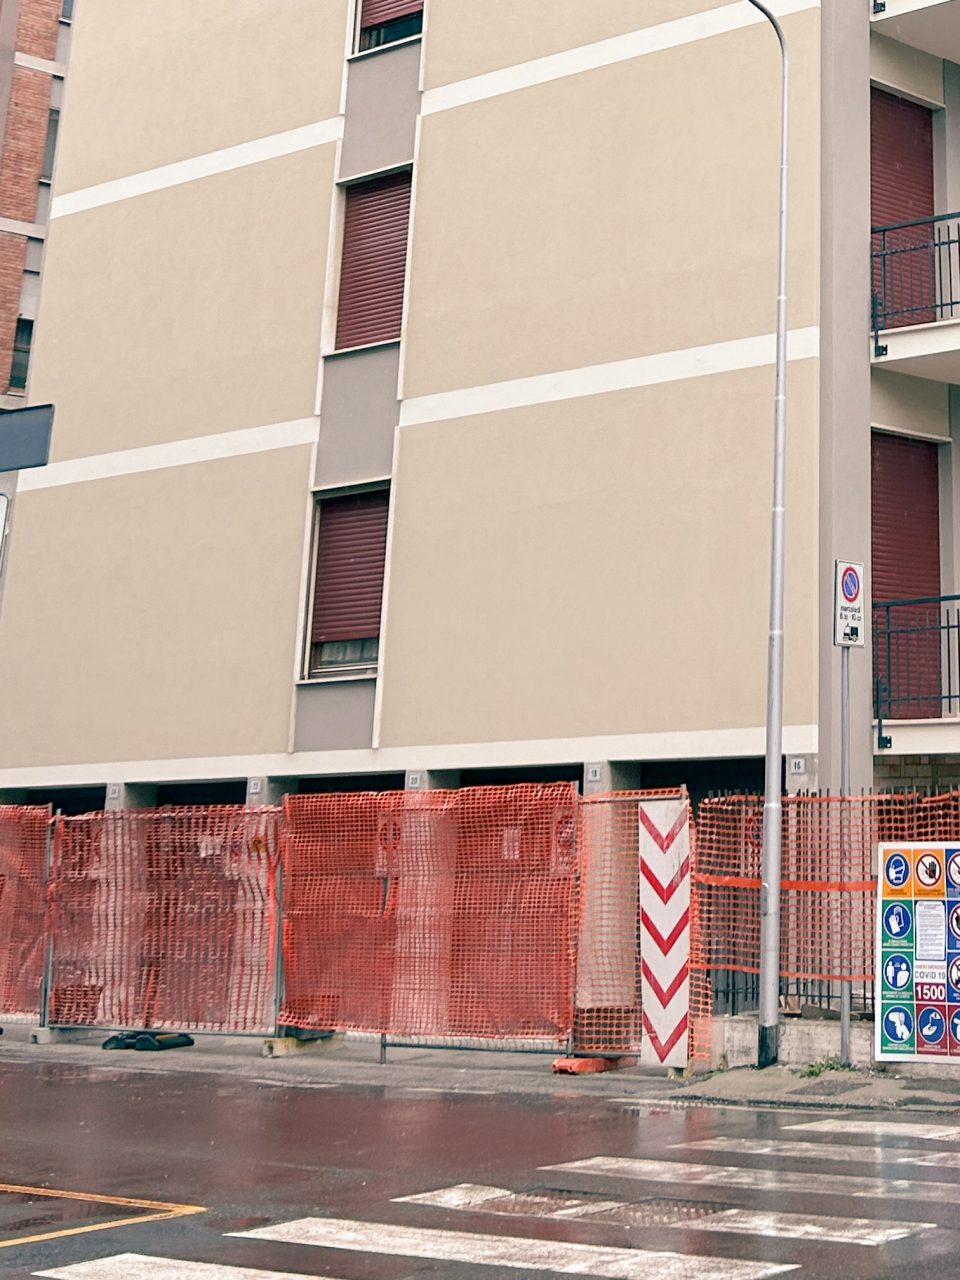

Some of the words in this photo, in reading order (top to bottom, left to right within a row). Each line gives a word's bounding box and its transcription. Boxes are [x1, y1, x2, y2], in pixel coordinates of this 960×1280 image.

[793, 760, 801, 771] 16
[914, 970, 937, 979] COVID
[938, 971, 946, 980] 19
[916, 984, 945, 1001] 1500
